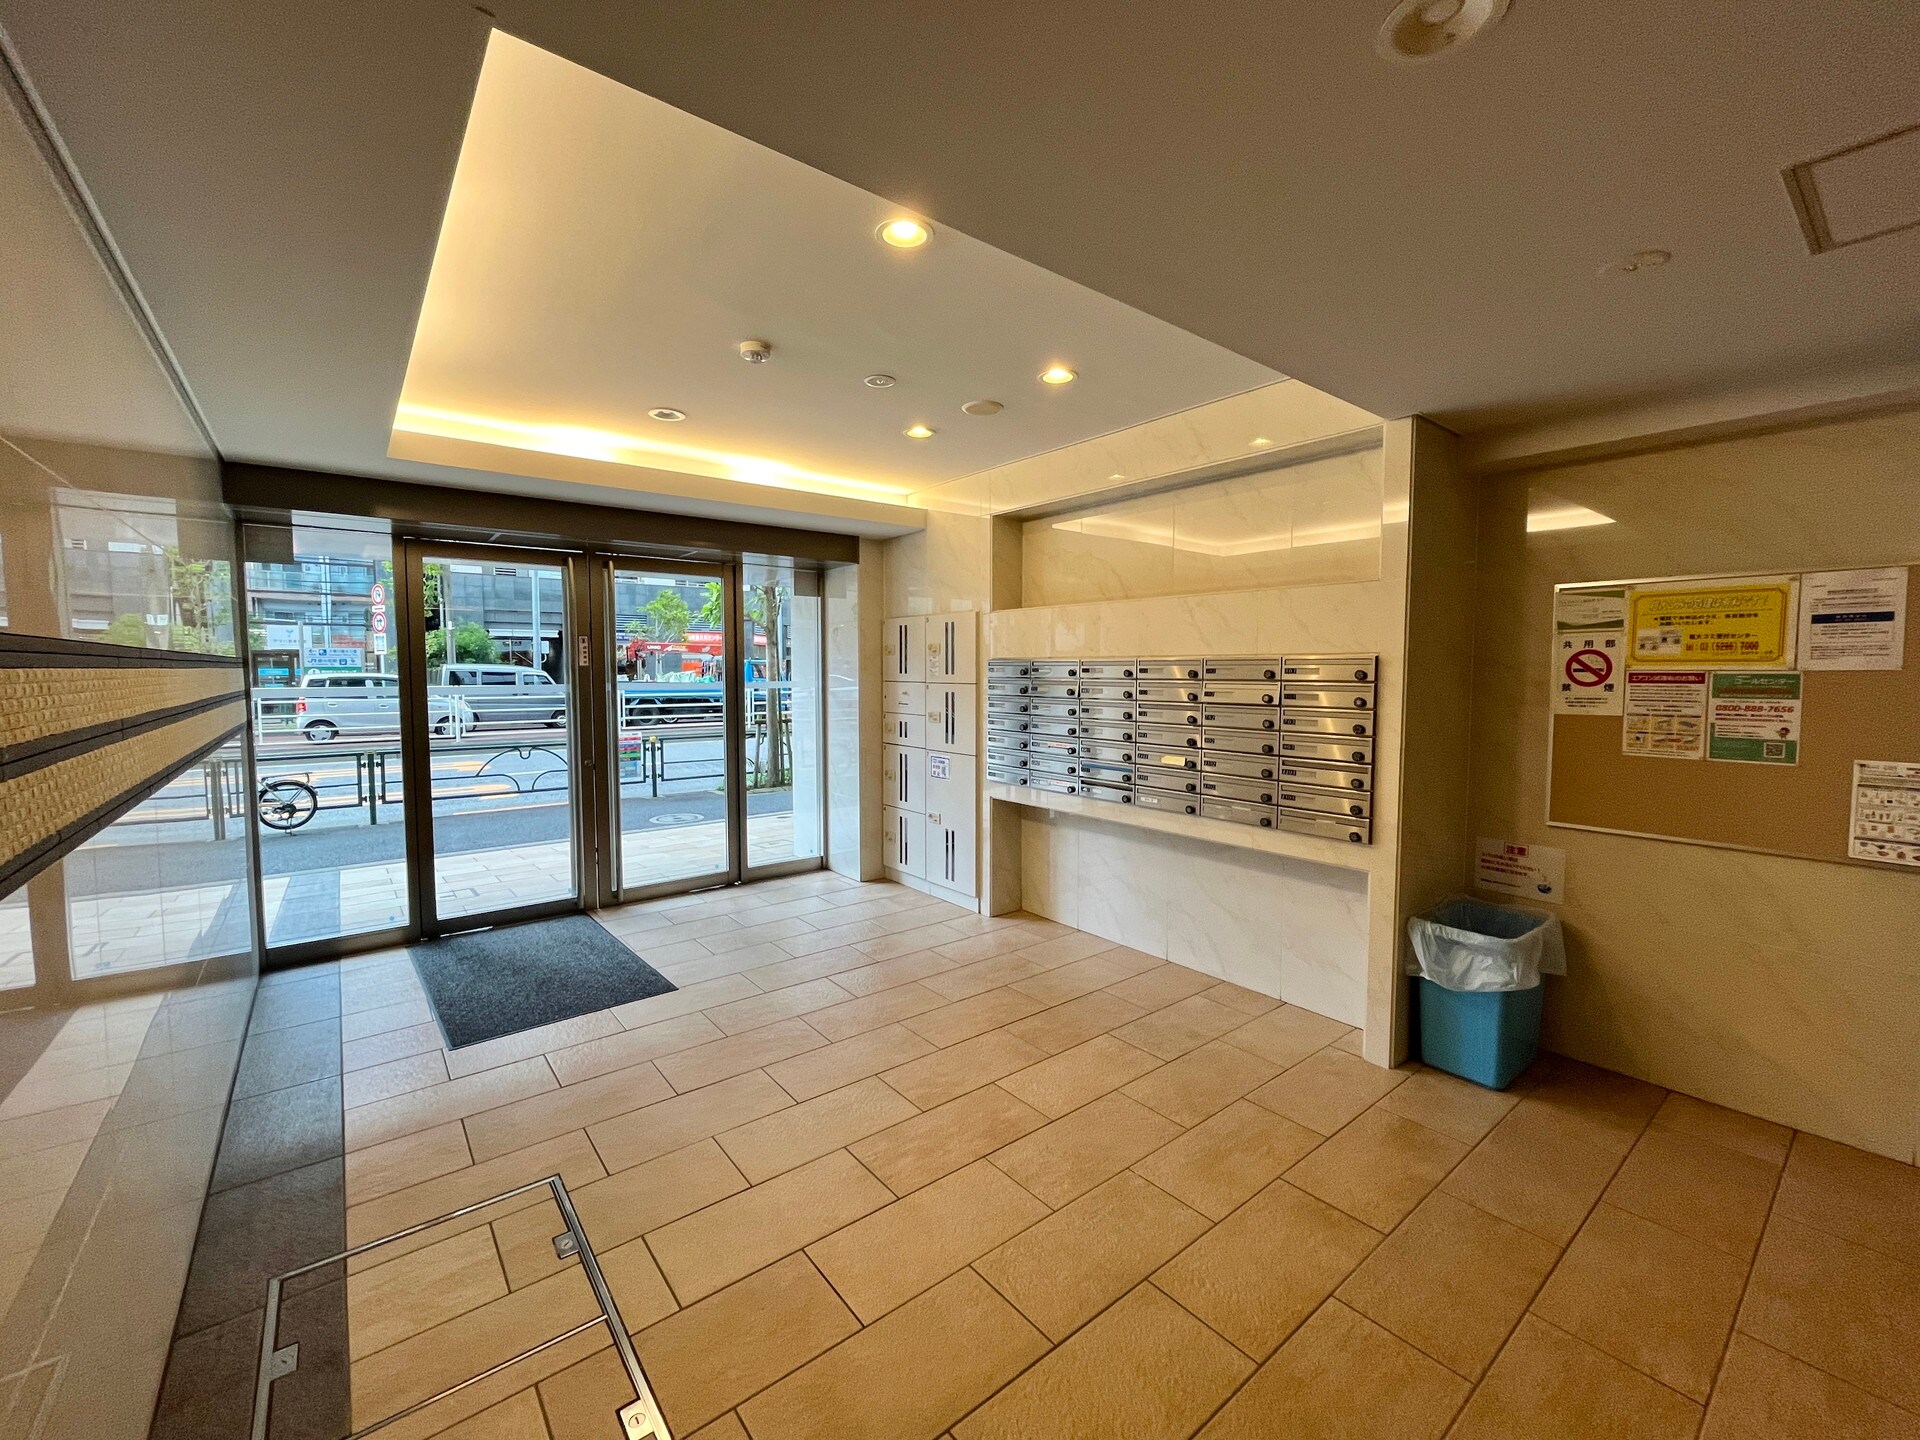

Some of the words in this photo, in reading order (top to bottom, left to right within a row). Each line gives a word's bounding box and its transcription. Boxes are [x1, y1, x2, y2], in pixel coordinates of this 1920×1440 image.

[1563, 639, 1616, 649] 共用部
[1561, 683, 1614, 692] 禁煙
[1715, 704, 1794, 713] 0800-888-7656
[1506, 845, 1526, 856] 注意
